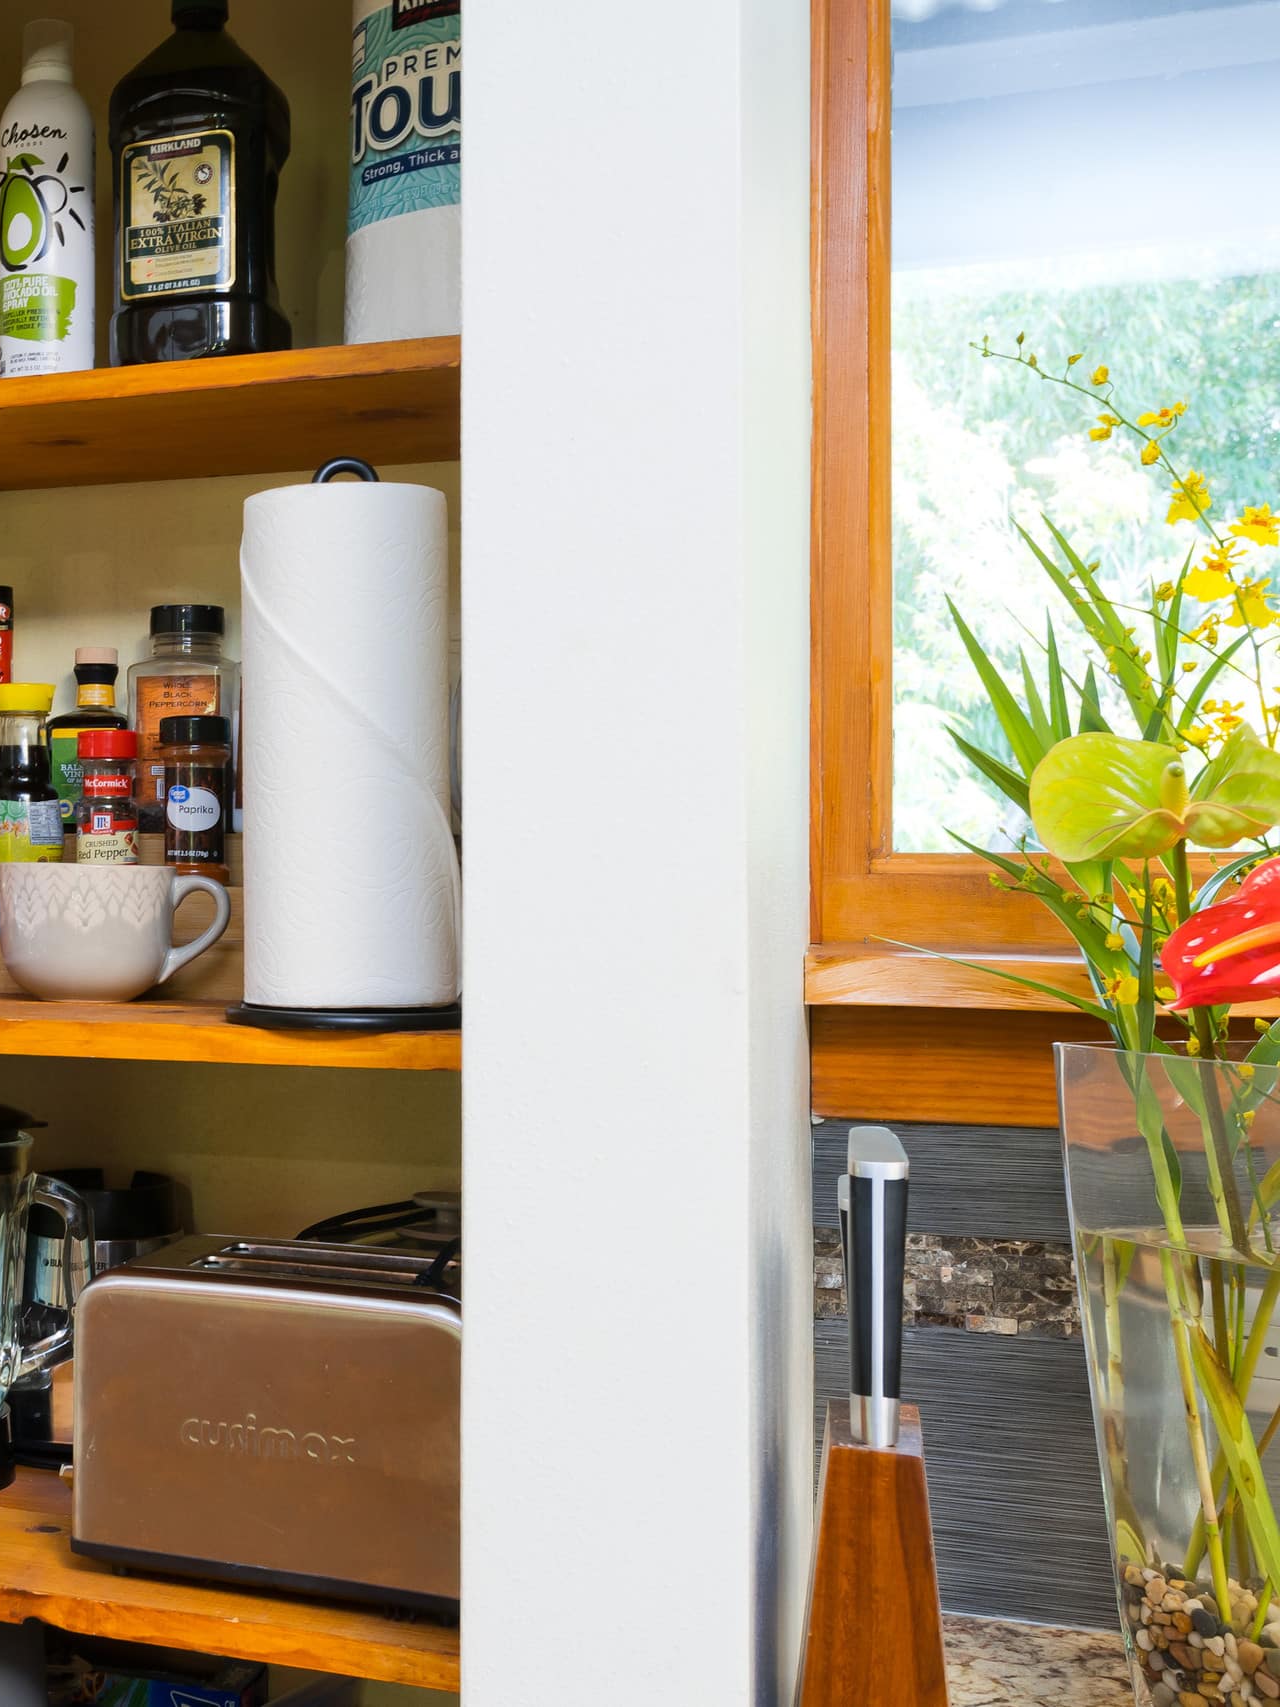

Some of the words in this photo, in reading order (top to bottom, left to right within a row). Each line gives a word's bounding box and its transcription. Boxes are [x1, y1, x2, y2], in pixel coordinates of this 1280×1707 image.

[150, 138, 201, 154] KIRKLAND
[364, 161, 405, 182] Strong,
[409, 150, 446, 166] Thick
[140, 228, 164, 237] 100%
[167, 219, 211, 233] ITALIAN
[131, 235, 174, 250] EXTRA
[176, 227, 224, 242] VIRGIN
[155, 244, 180, 254] OLIVE
[182, 241, 197, 250] OIL
[23, 275, 49, 288] PURE
[41, 286, 59, 297] OIL
[2, 297, 29, 312] SPRAY
[85, 778, 128, 789] McCormick
[178, 805, 214, 815] Paprika
[85, 839, 118, 848] CRUSHED
[78, 849, 92, 860] Red
[94, 847, 129, 861] Pepper
[181, 1413, 356, 1465] cusimax
